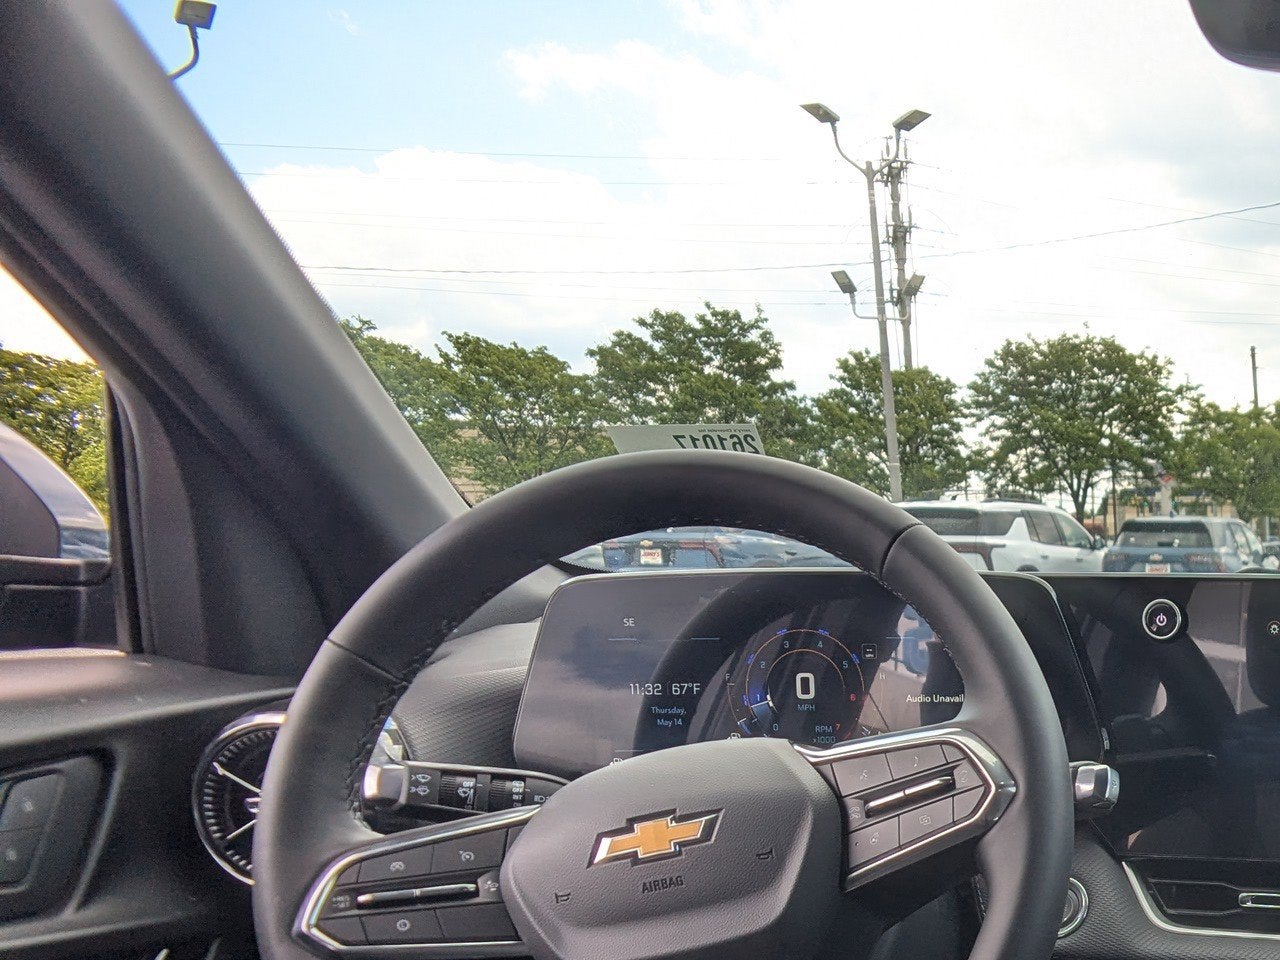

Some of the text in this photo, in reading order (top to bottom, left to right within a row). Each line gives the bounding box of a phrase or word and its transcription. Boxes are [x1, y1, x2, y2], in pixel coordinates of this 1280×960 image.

[623, 618, 635, 627] SE
[760, 661, 766, 669] 2
[842, 661, 848, 669] 5
[629, 683, 701, 695] 11:32 67°F
[795, 672, 815, 700] 0
[906, 694, 931, 703] Audio
[651, 706, 687, 715] Thursday,
[657, 719, 673, 727] May
[812, 736, 836, 744] x1000
[641, 875, 685, 894] AIRBAG
